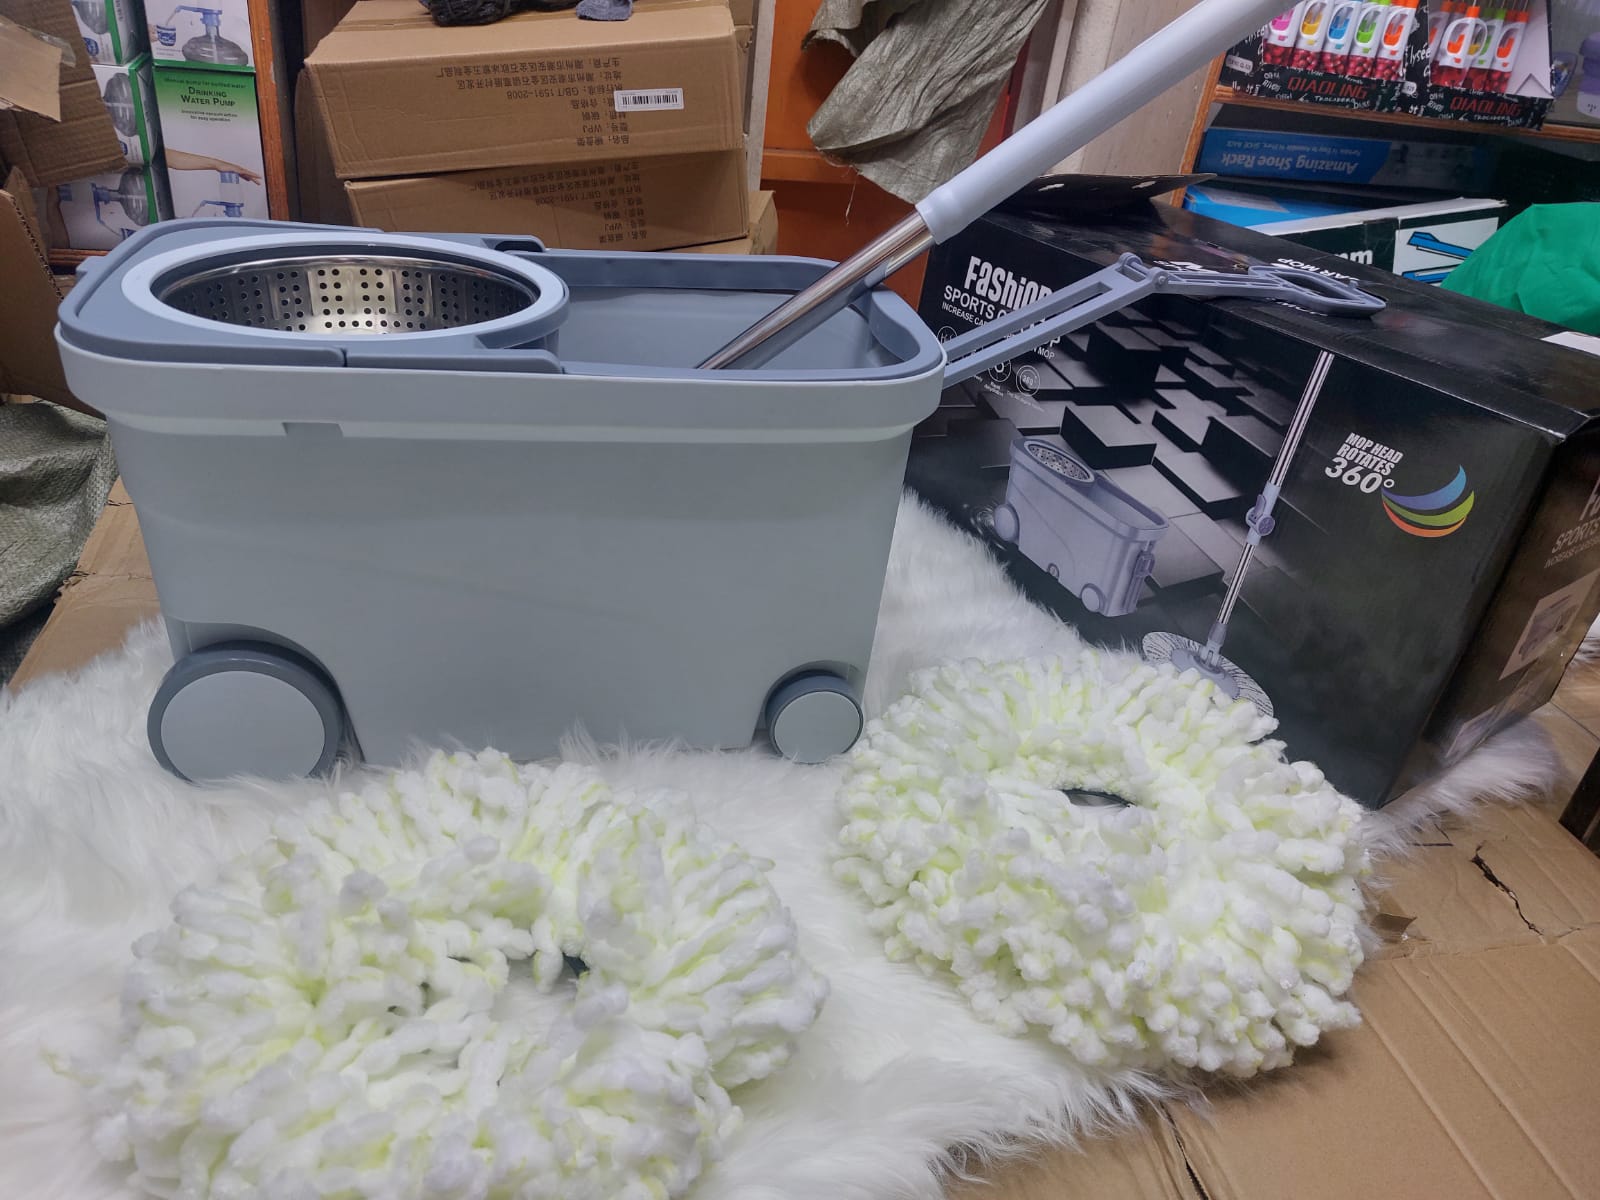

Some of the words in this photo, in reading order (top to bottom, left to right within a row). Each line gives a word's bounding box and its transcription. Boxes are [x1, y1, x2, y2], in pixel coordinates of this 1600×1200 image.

[1287, 76, 1368, 99] QIAOLING
[181, 94, 210, 105] WATER
[213, 97, 236, 107] PUMP
[1449, 96, 1521, 117] QIAOLING
[1221, 152, 1256, 169] Rack
[1257, 154, 1292, 171] Shoe
[1295, 155, 1359, 175] Amazing
[942, 302, 974, 323] INCREASE
[943, 285, 996, 319] SPORTS
[1345, 432, 1374, 450] MOP
[1370, 443, 1404, 463] HEAD
[1336, 443, 1395, 476] ROTATES
[1325, 456, 1395, 493] 360°
